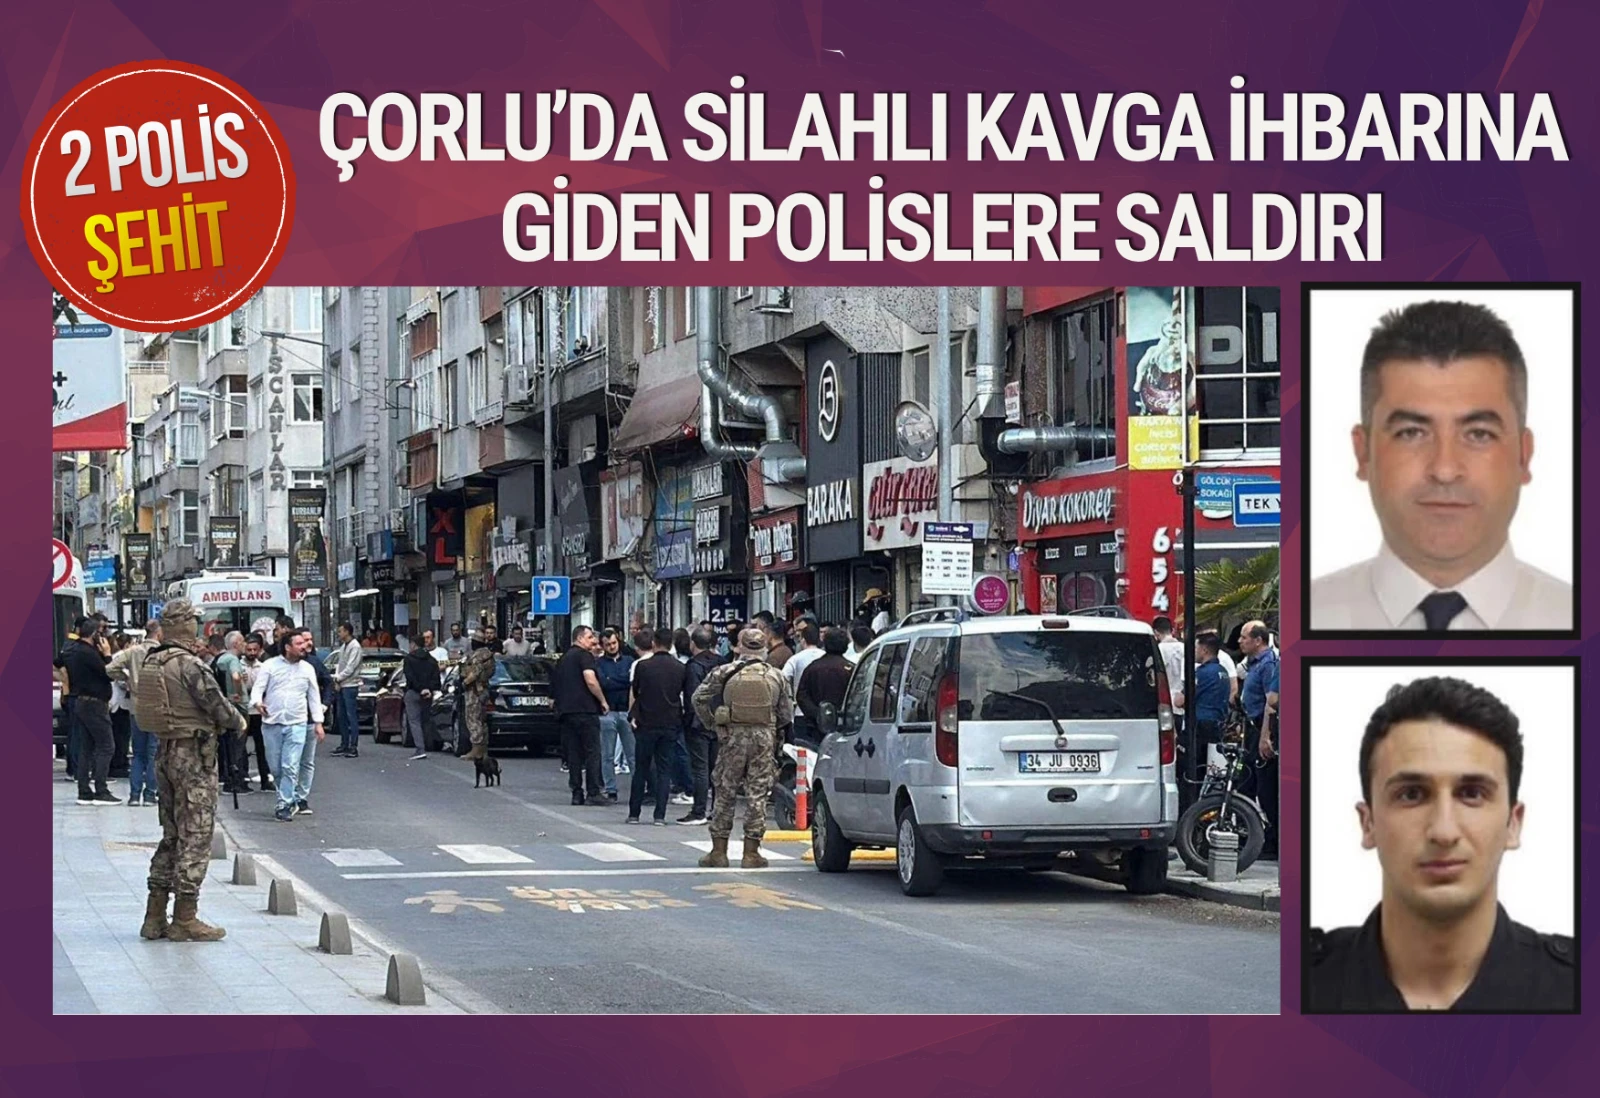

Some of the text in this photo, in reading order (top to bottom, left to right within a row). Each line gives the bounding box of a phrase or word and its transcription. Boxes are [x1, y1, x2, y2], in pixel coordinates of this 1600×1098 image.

[807, 478, 853, 527] BARAKA
[1245, 498, 1270, 509] TEK
[540, 580, 561, 610] P
[709, 583, 745, 595] SIFIR
[202, 590, 272, 603] AMBULANS
[711, 608, 744, 623] 2.EL
[1027, 753, 1098, 767] 34 JU 0936
